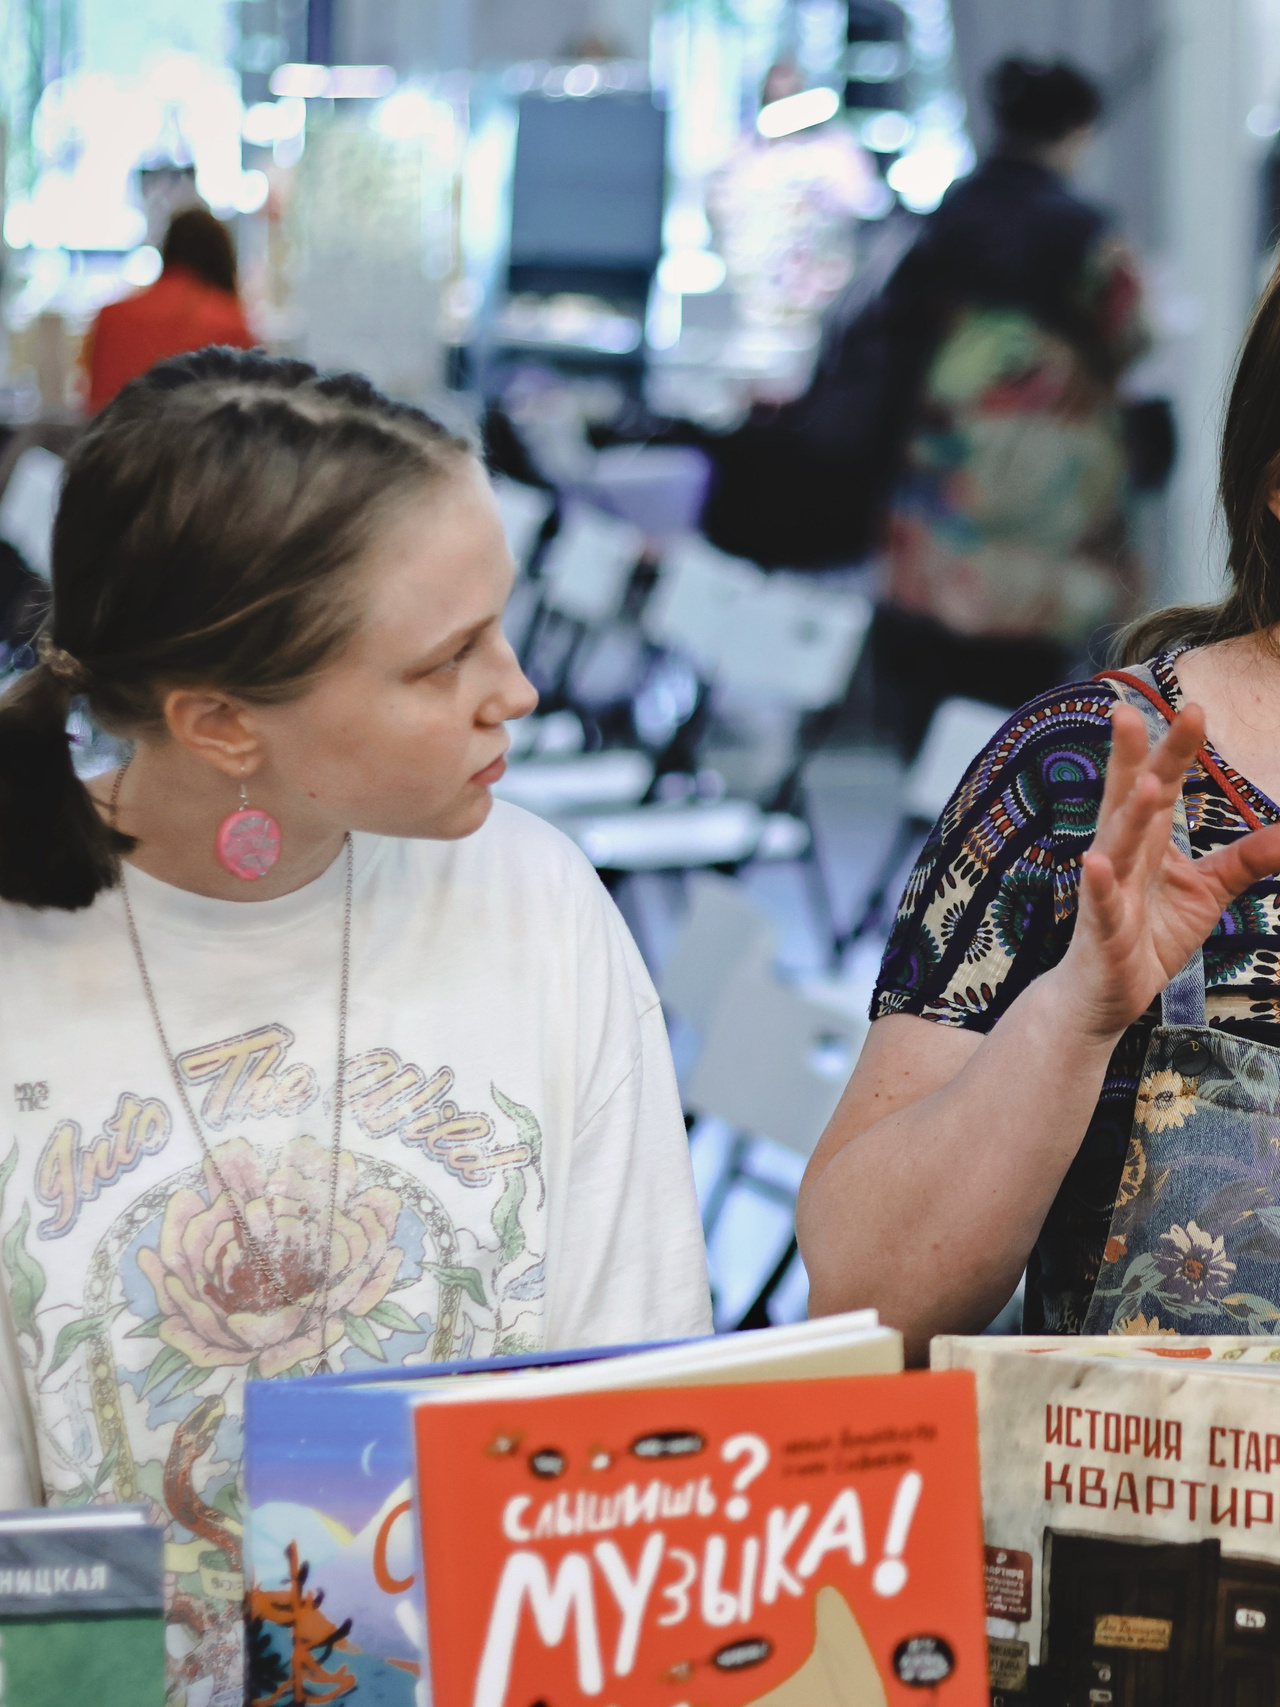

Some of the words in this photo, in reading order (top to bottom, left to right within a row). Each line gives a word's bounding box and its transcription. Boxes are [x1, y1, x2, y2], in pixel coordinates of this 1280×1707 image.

[36, 1092, 173, 1241] Into
[176, 1022, 321, 1130] The
[328, 1047, 533, 1187] Wild
[1044, 1403, 1183, 1462] ИСТОРИЯ
[473, 1471, 923, 1707] МУЗЫКА!
